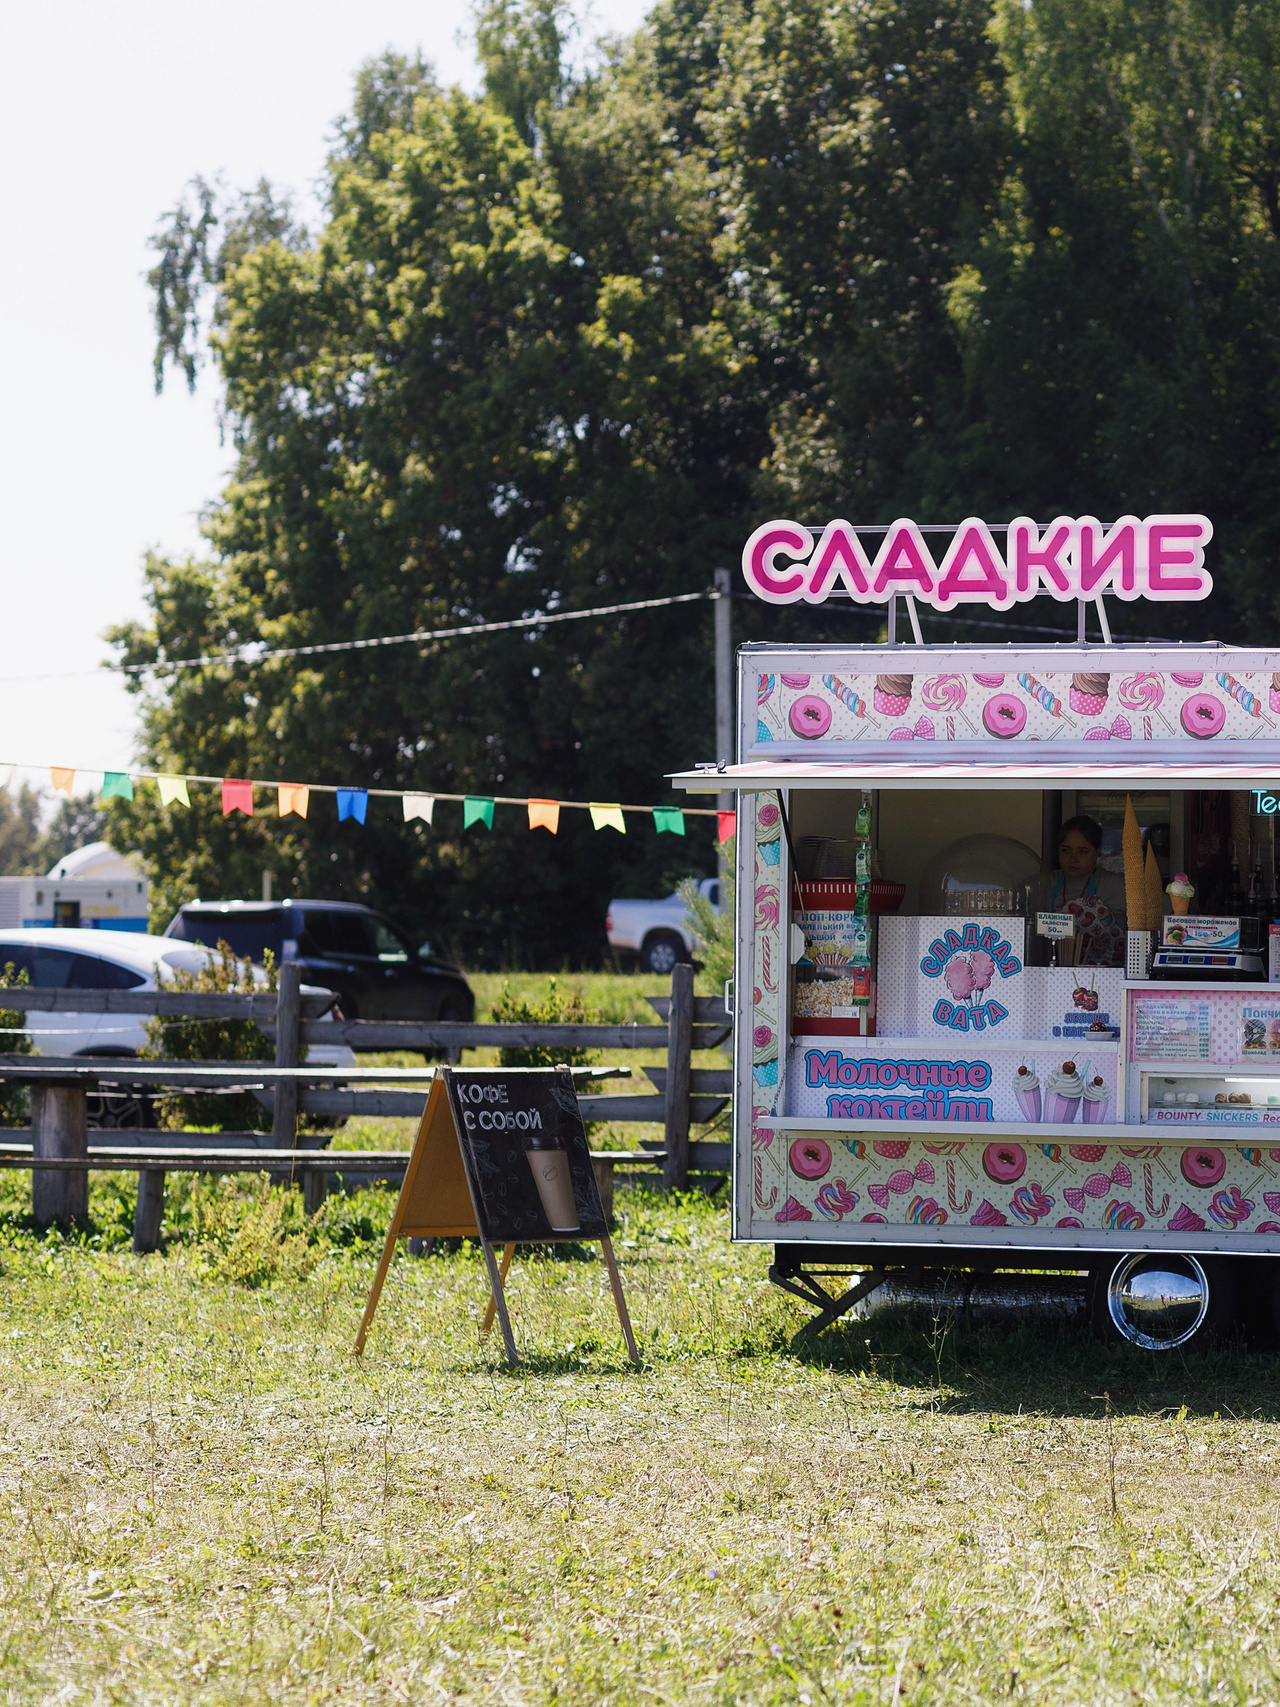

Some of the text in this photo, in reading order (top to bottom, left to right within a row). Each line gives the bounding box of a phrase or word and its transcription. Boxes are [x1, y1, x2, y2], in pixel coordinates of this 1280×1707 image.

[747, 521, 1207, 603] СЛАДКИЕ
[922, 925, 1020, 976] СЛАДКАЯ
[934, 1000, 1008, 1030] ВАТА
[807, 1051, 990, 1089] Молочные
[457, 1084, 509, 1104] КОФЕ
[829, 1091, 993, 1121] коктейли
[463, 1107, 543, 1130] С СОБОЙ
[1157, 1111, 1201, 1121] BOUNTY
[1206, 1112, 1259, 1122] SNICKERS
